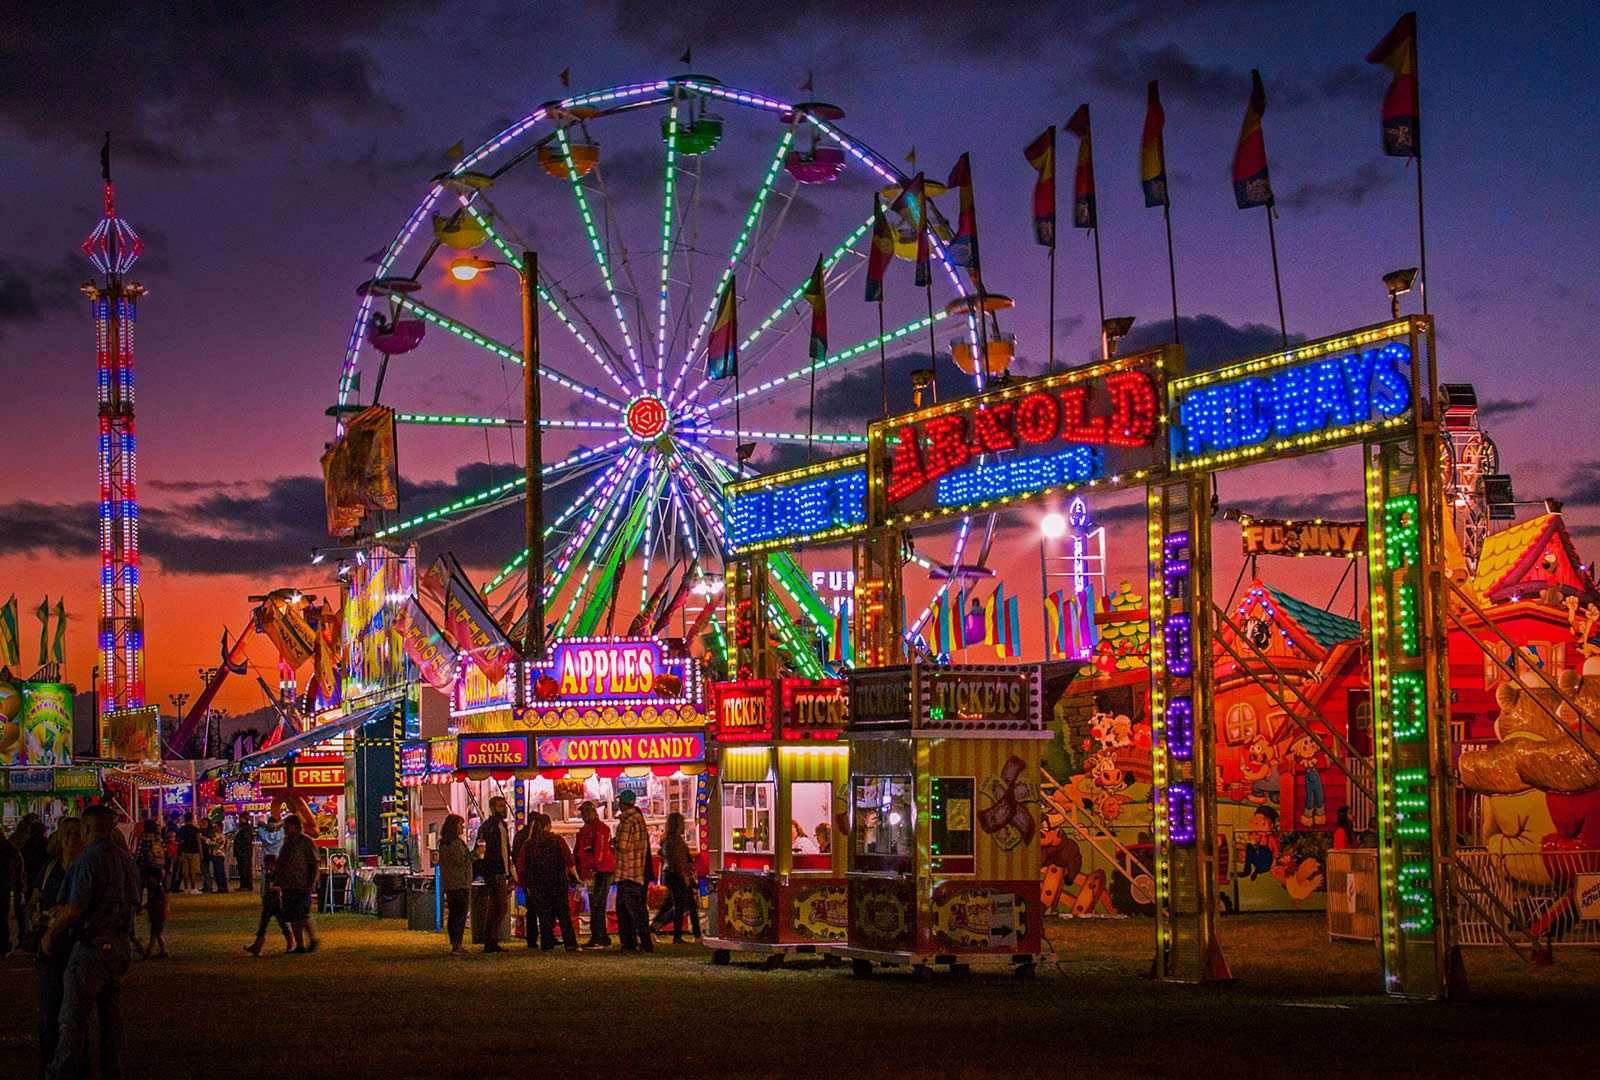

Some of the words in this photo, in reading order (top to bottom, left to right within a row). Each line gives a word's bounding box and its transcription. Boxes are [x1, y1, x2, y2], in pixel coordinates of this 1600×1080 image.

[1180, 342, 1412, 455] MIDWAYS
[886, 370, 1156, 503] ARNOLD
[1245, 525, 1360, 551] FUNNY
[560, 648, 655, 696] APPLES
[935, 680, 1022, 715] TICKETS
[1163, 531, 1196, 846] FOOD
[723, 696, 766, 727] TICKET
[794, 694, 849, 725] TICKE
[1384, 496, 1434, 936] RIDES
[467, 752, 523, 765] DRINKS
[480, 742, 510, 754] COLD
[567, 738, 633, 761] COTTON
[636, 736, 694, 759] CANDY
[298, 767, 345, 784] PRET
